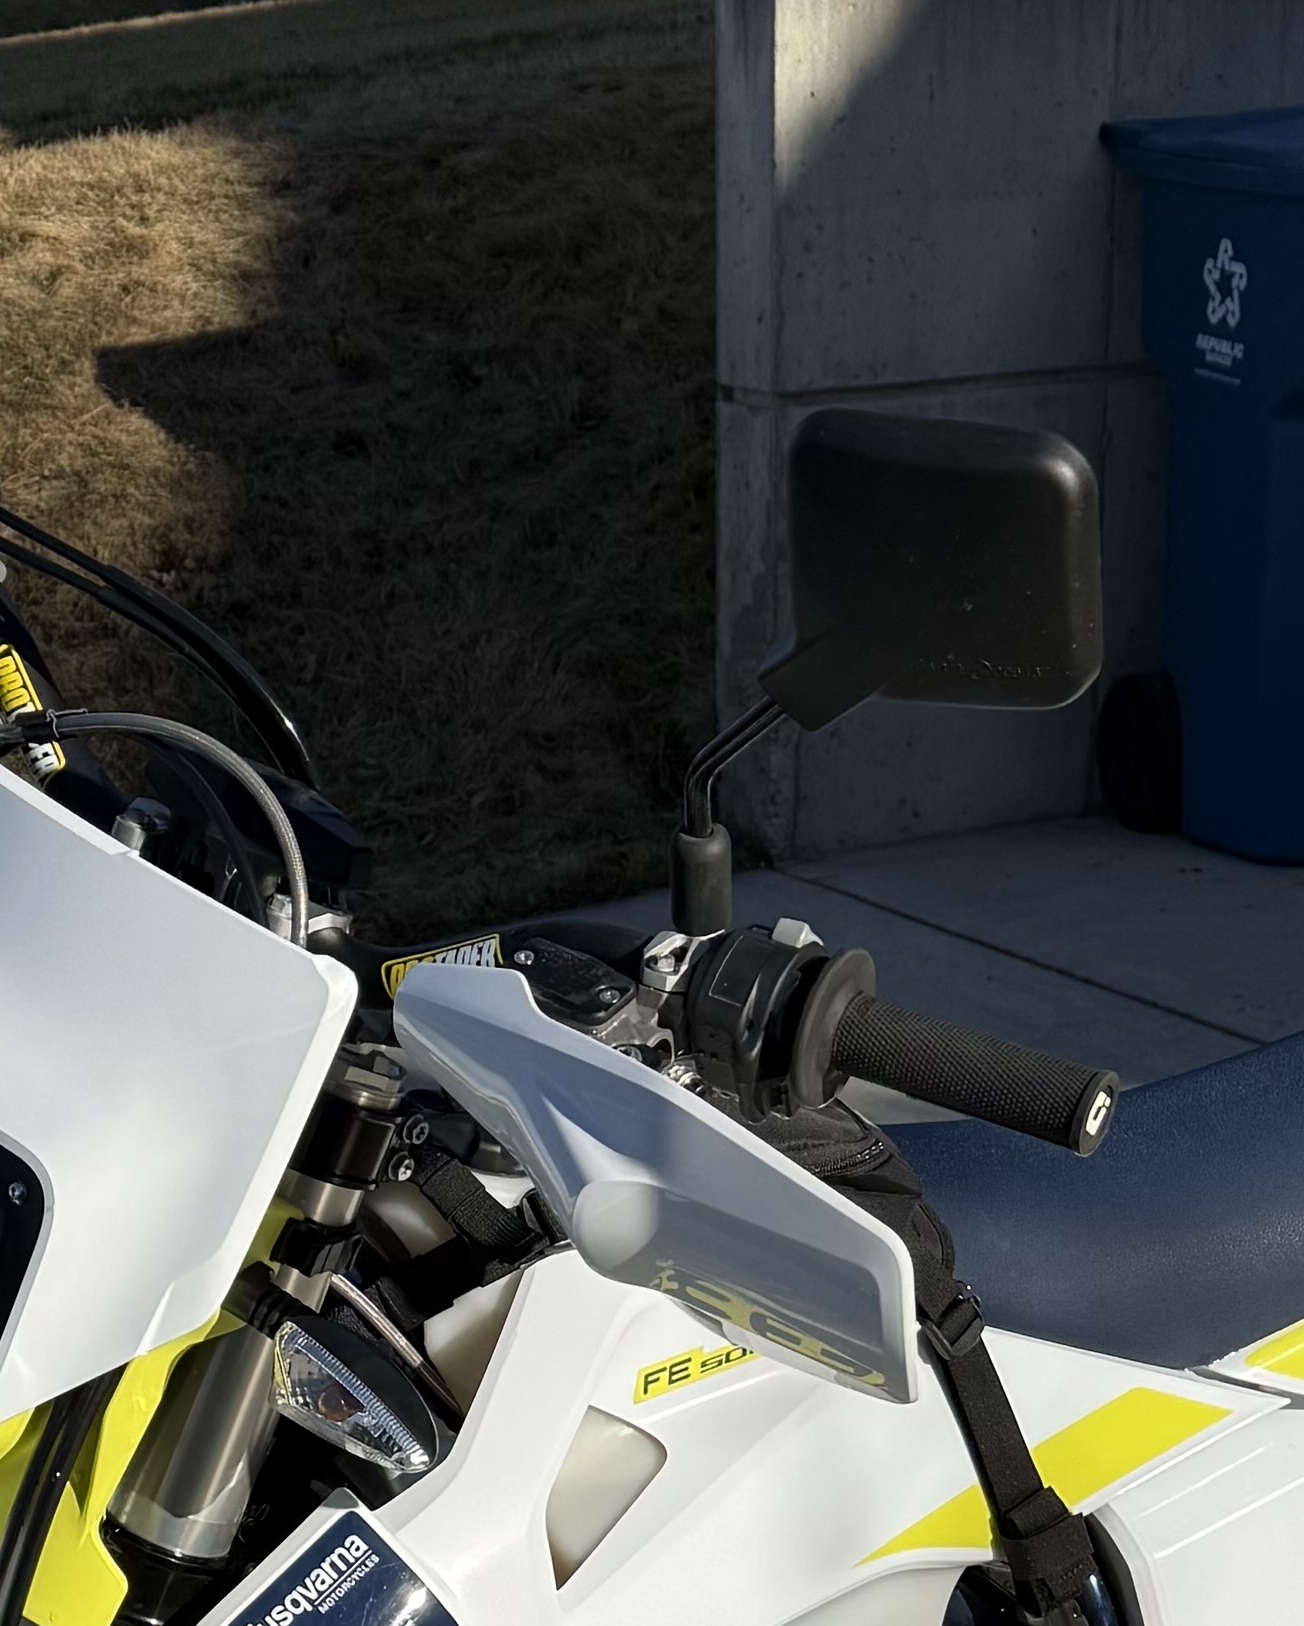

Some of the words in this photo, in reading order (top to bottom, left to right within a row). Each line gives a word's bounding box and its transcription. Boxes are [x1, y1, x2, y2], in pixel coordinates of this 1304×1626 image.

[643, 1357, 692, 1396] FE
[700, 1346, 754, 1374] 50
[317, 1554, 380, 1615] MOTORCYCLES
